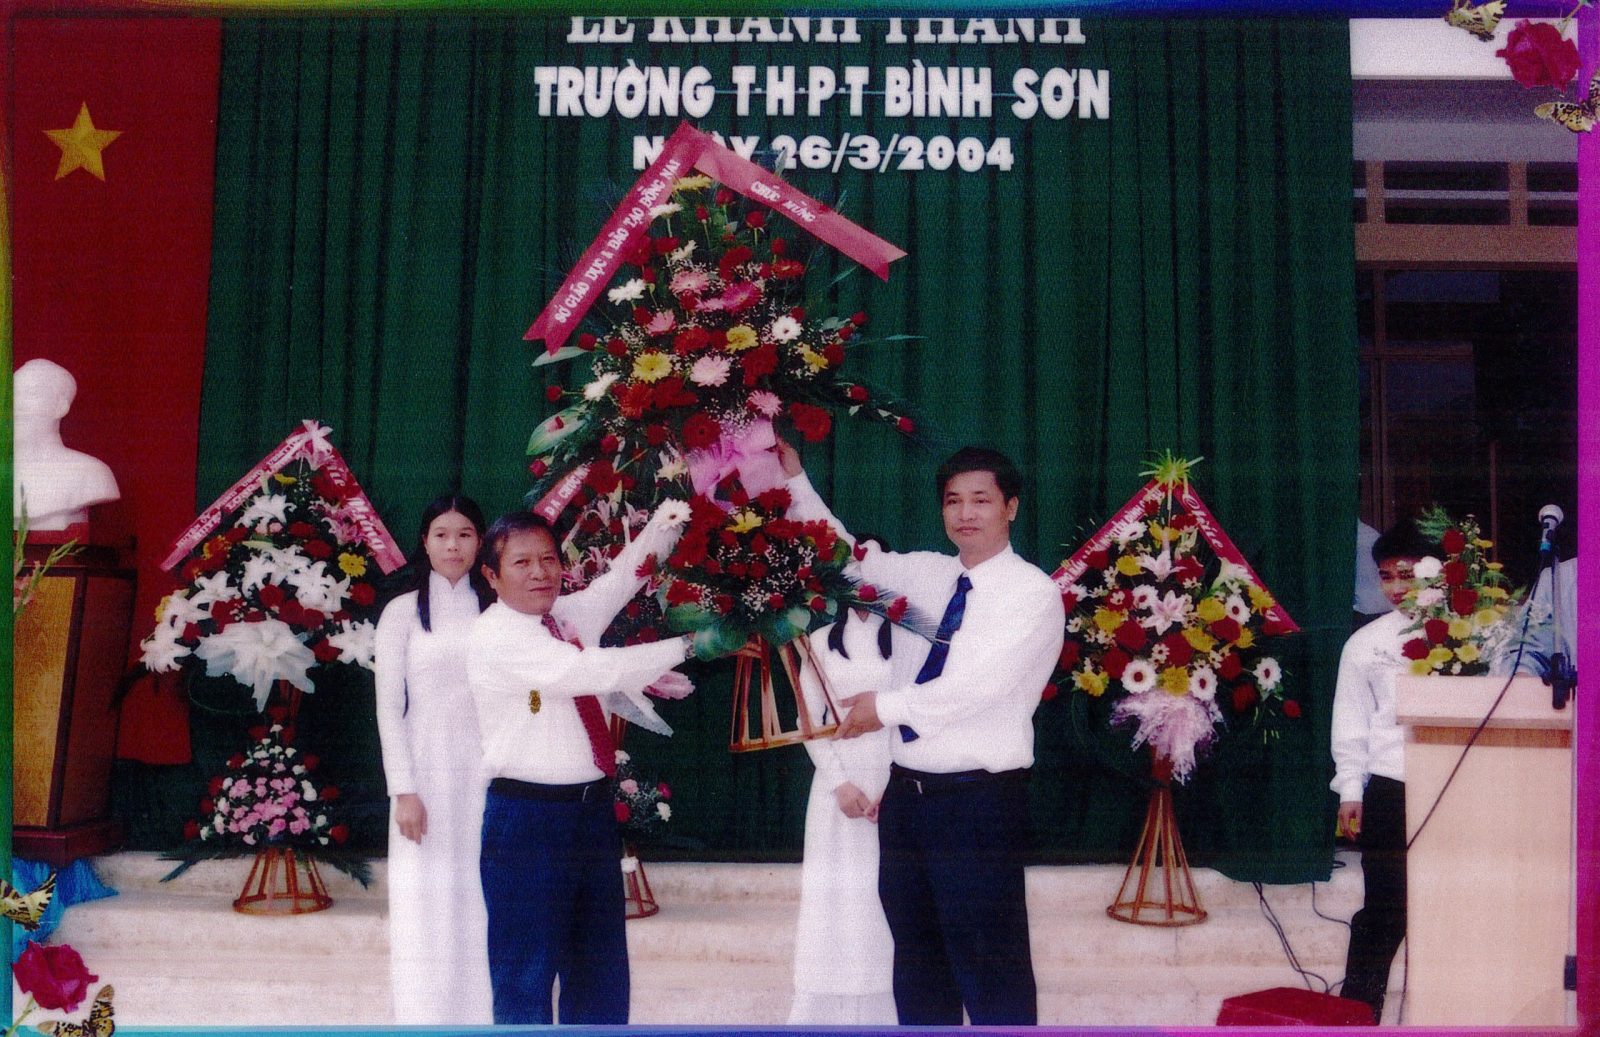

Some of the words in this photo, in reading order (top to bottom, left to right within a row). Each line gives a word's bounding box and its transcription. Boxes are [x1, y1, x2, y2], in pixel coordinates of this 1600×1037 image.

[534, 58, 715, 118] TRƯỜNG
[885, 59, 992, 118] BÌNH
[1011, 67, 1110, 120] SƠN
[772, 132, 1014, 173] 26/3/2004
